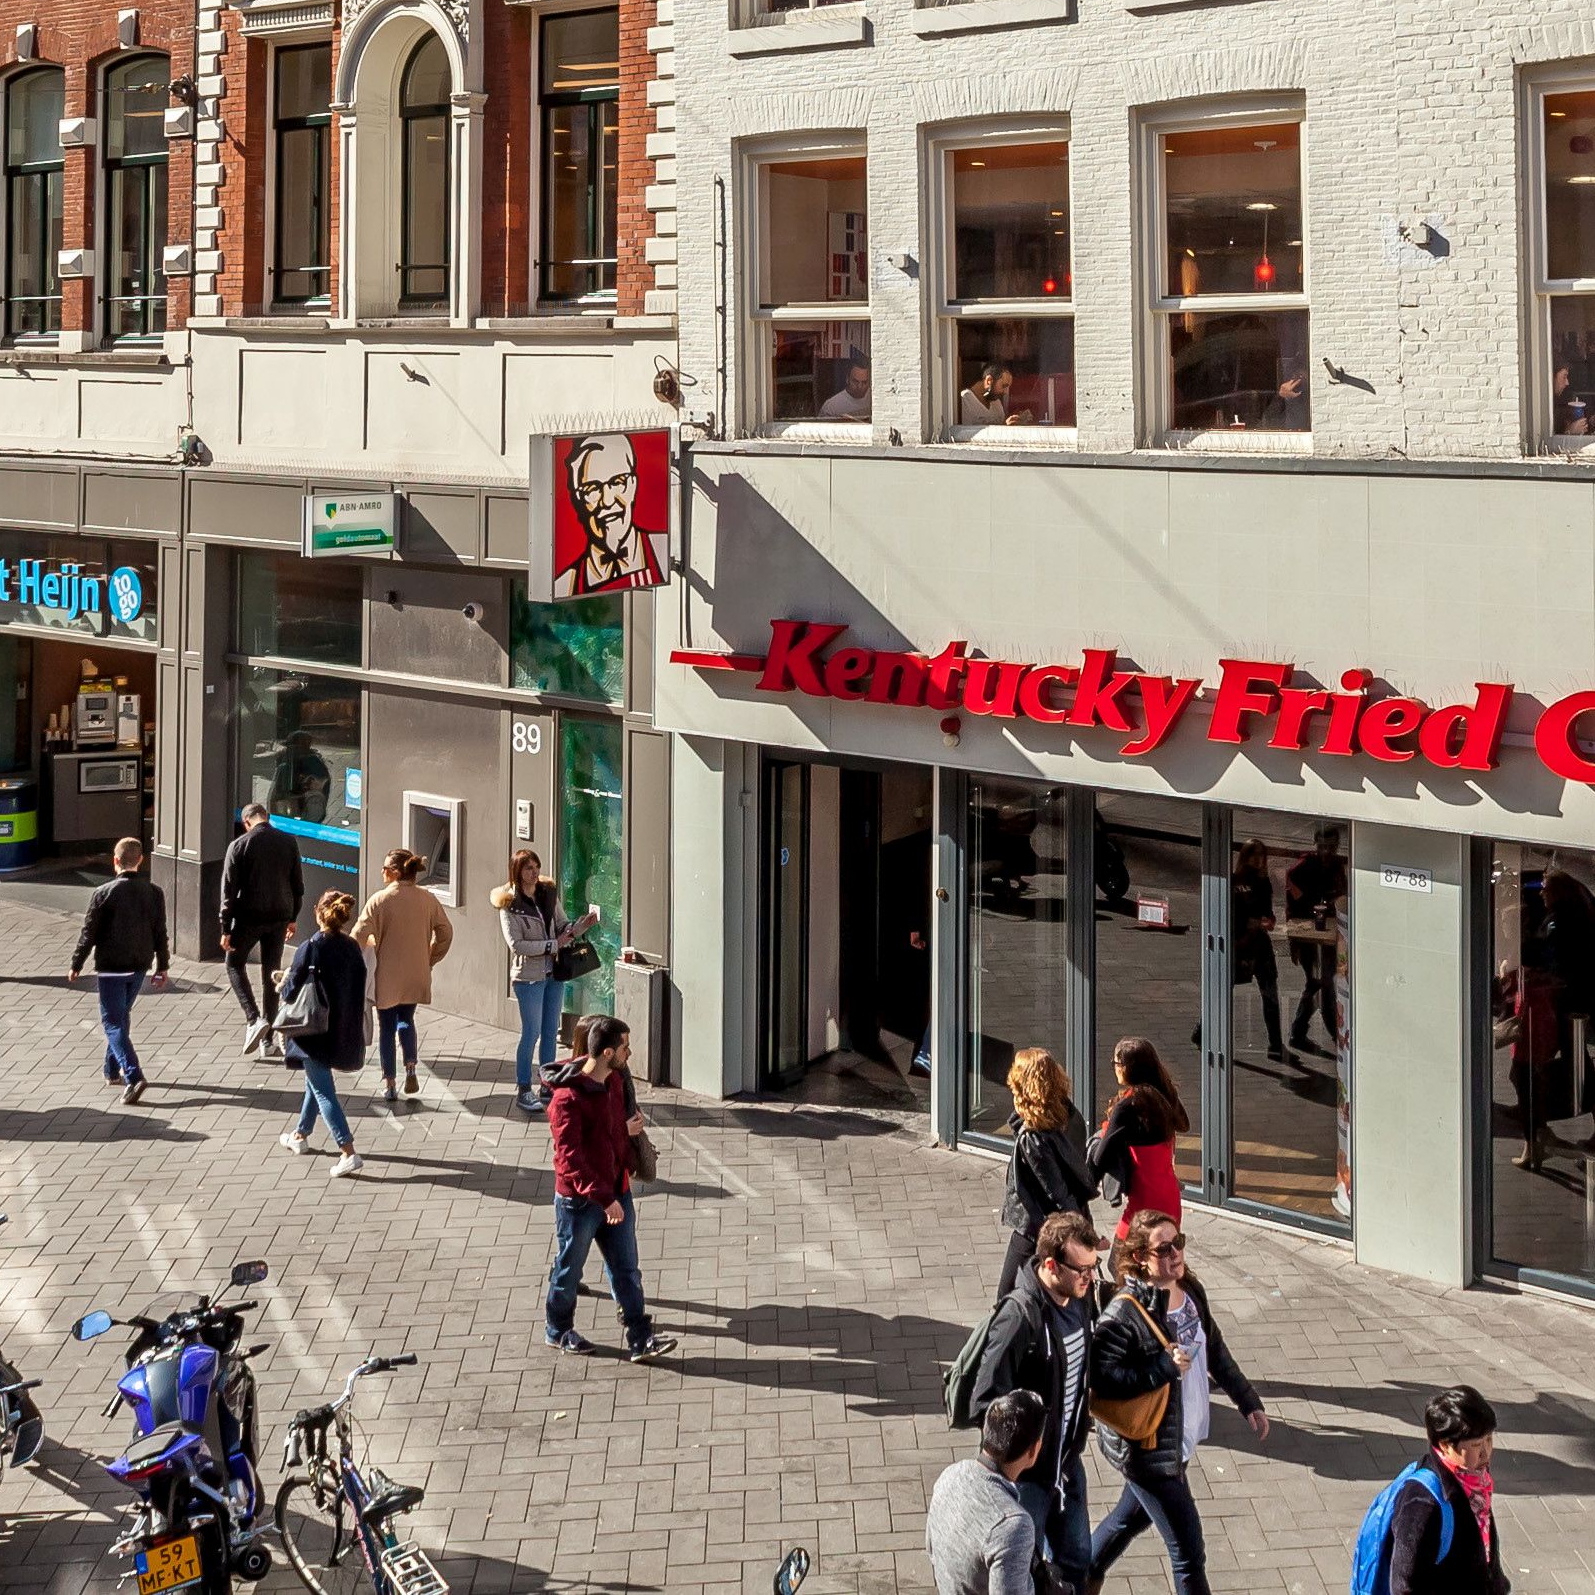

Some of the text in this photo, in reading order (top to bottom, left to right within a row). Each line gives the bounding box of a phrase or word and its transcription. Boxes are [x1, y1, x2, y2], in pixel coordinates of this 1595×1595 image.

[19, 558, 101, 621] Heijn
[114, 573, 132, 597] to
[118, 590, 138, 620] go
[756, 618, 1202, 755] Kentucky
[1207, 658, 1515, 771] Fried
[512, 721, 541, 755] 89
[1384, 868, 1427, 888] 87-88
[159, 1543, 183, 1565] 59
